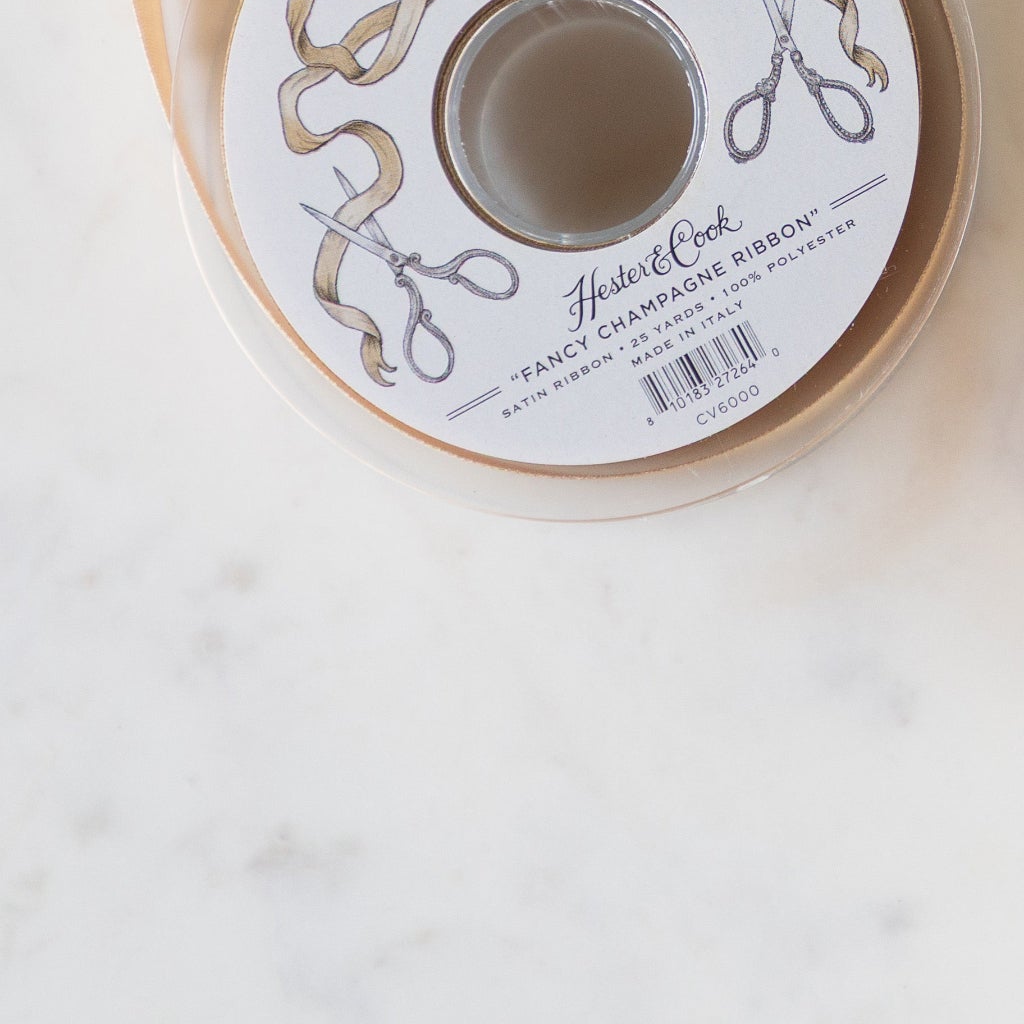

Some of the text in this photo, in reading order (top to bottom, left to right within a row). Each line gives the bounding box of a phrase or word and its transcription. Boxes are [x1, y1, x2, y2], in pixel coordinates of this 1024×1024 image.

[502, 219, 856, 419] SATIN RIBBON 25 YARDS 100% POLYESTER
[597, 261, 727, 340] CHAMPAGNE
[631, 300, 743, 368] MADE IN ITALY
[646, 347, 780, 426] 8 10183 27264 0
[696, 384, 760, 425] CV6000
